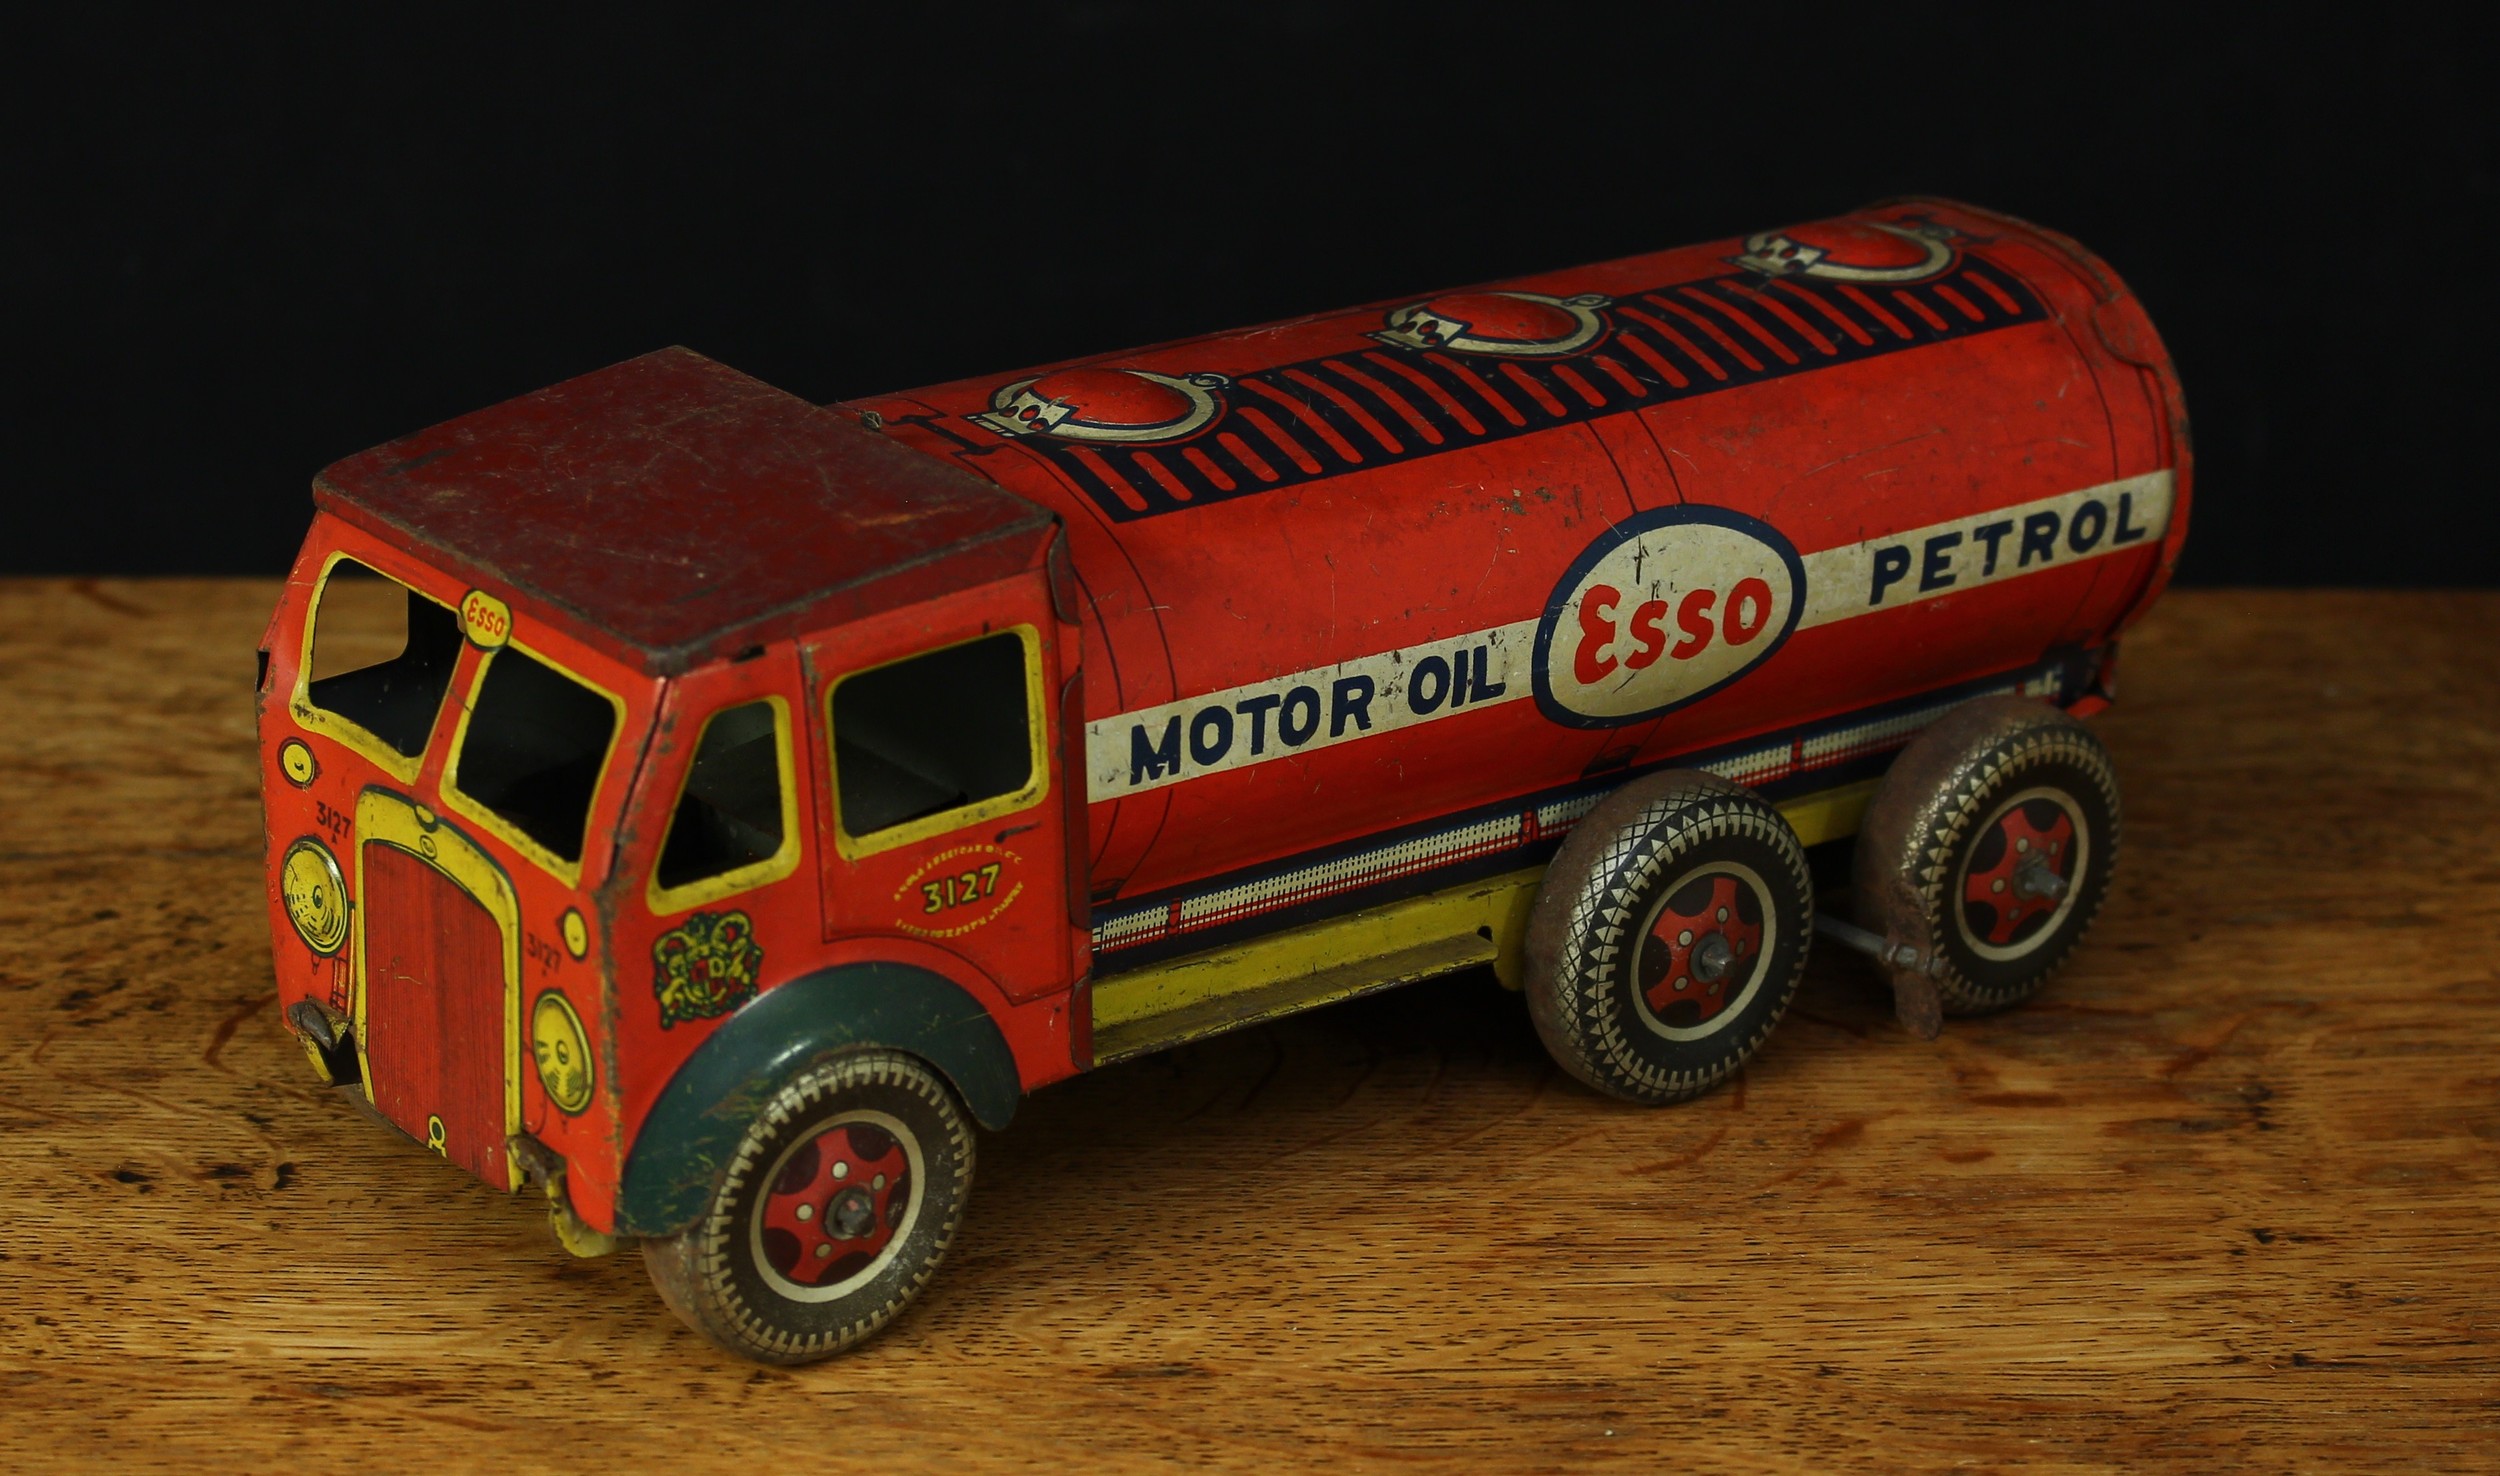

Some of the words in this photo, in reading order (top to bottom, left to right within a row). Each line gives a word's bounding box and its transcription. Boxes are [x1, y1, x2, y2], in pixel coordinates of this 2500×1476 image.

[1868, 493, 2148, 606] PETROL
[1129, 674, 1375, 786] MOTOR
[1408, 645, 1507, 715] OIL
[316, 801, 351, 838] 3127
[921, 861, 1002, 914] 3127
[527, 932, 561, 974] 3127
